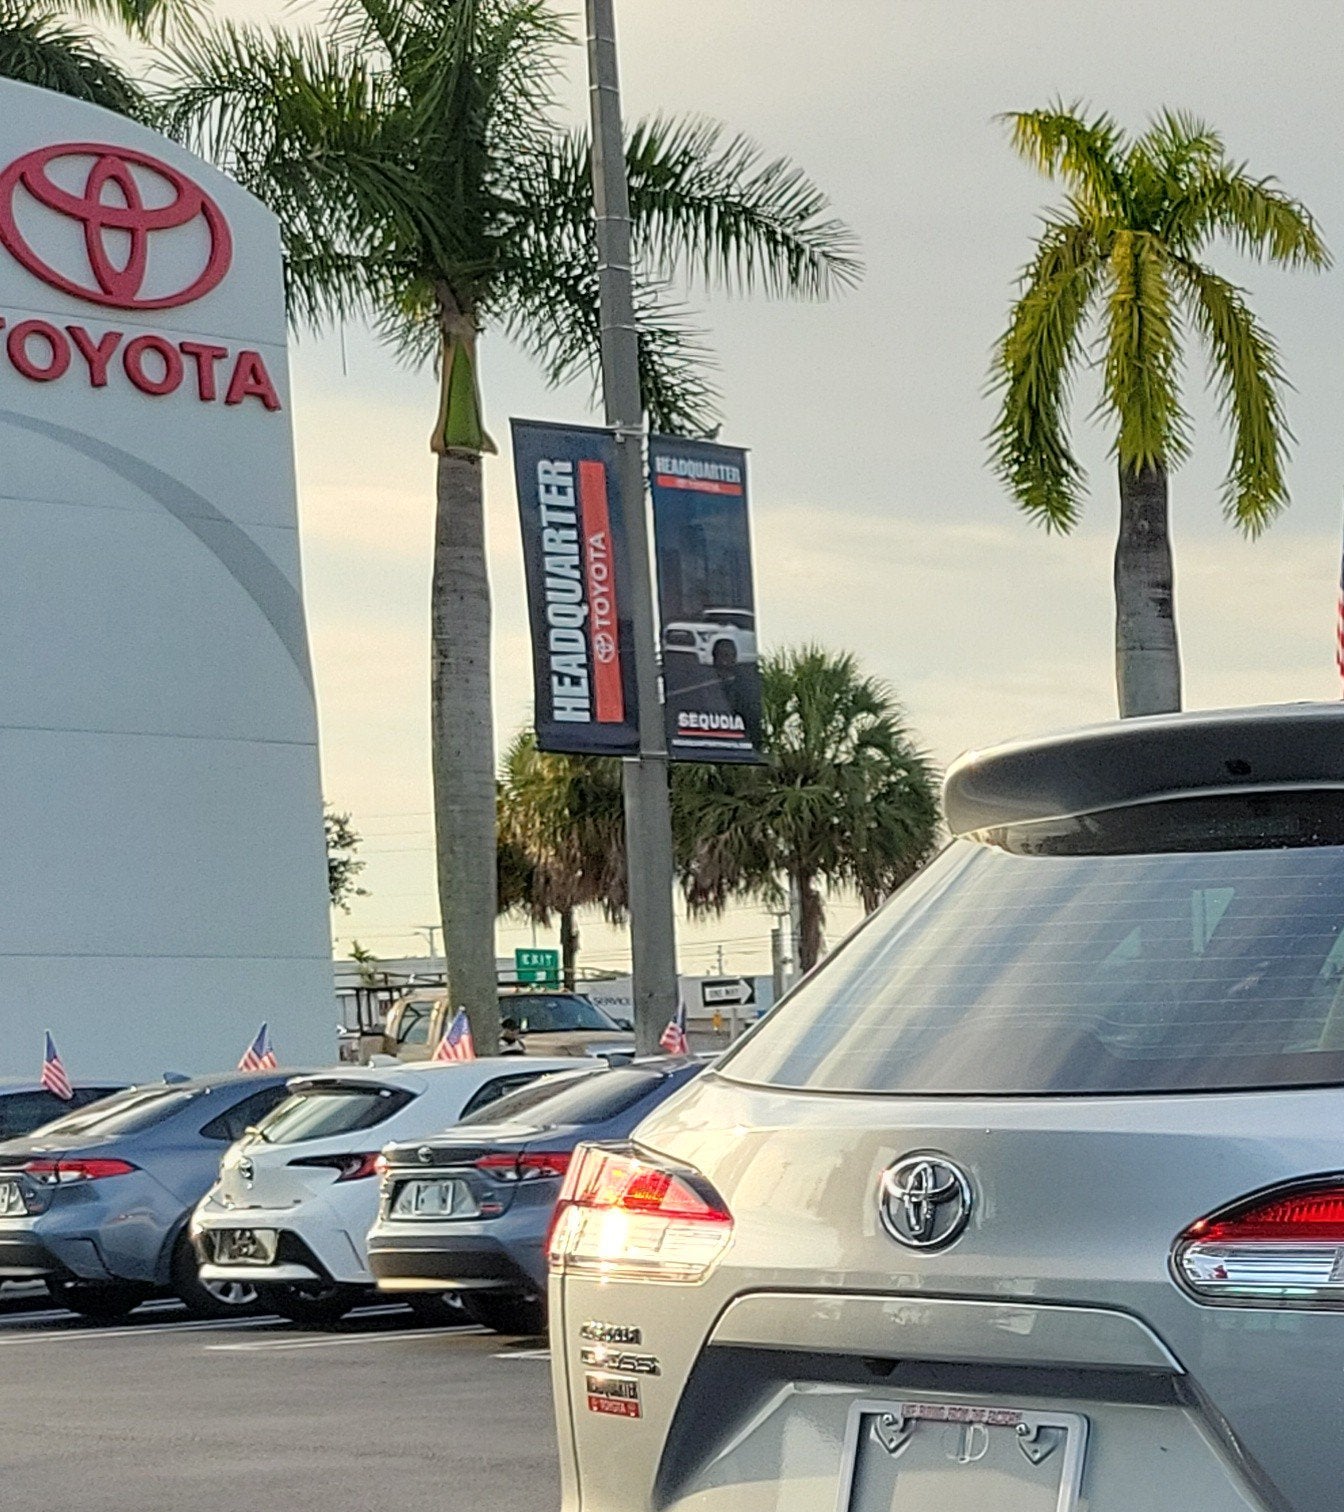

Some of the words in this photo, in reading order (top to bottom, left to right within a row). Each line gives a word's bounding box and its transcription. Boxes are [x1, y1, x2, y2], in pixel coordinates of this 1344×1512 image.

[0, 317, 281, 412] OYOTA
[655, 456, 740, 483] HEADQUARTER
[537, 458, 591, 723] HEADQUARTER
[589, 531, 612, 628] TOYOTA
[678, 711, 745, 730] SEQUOIA
[521, 953, 553, 967] EXIT
